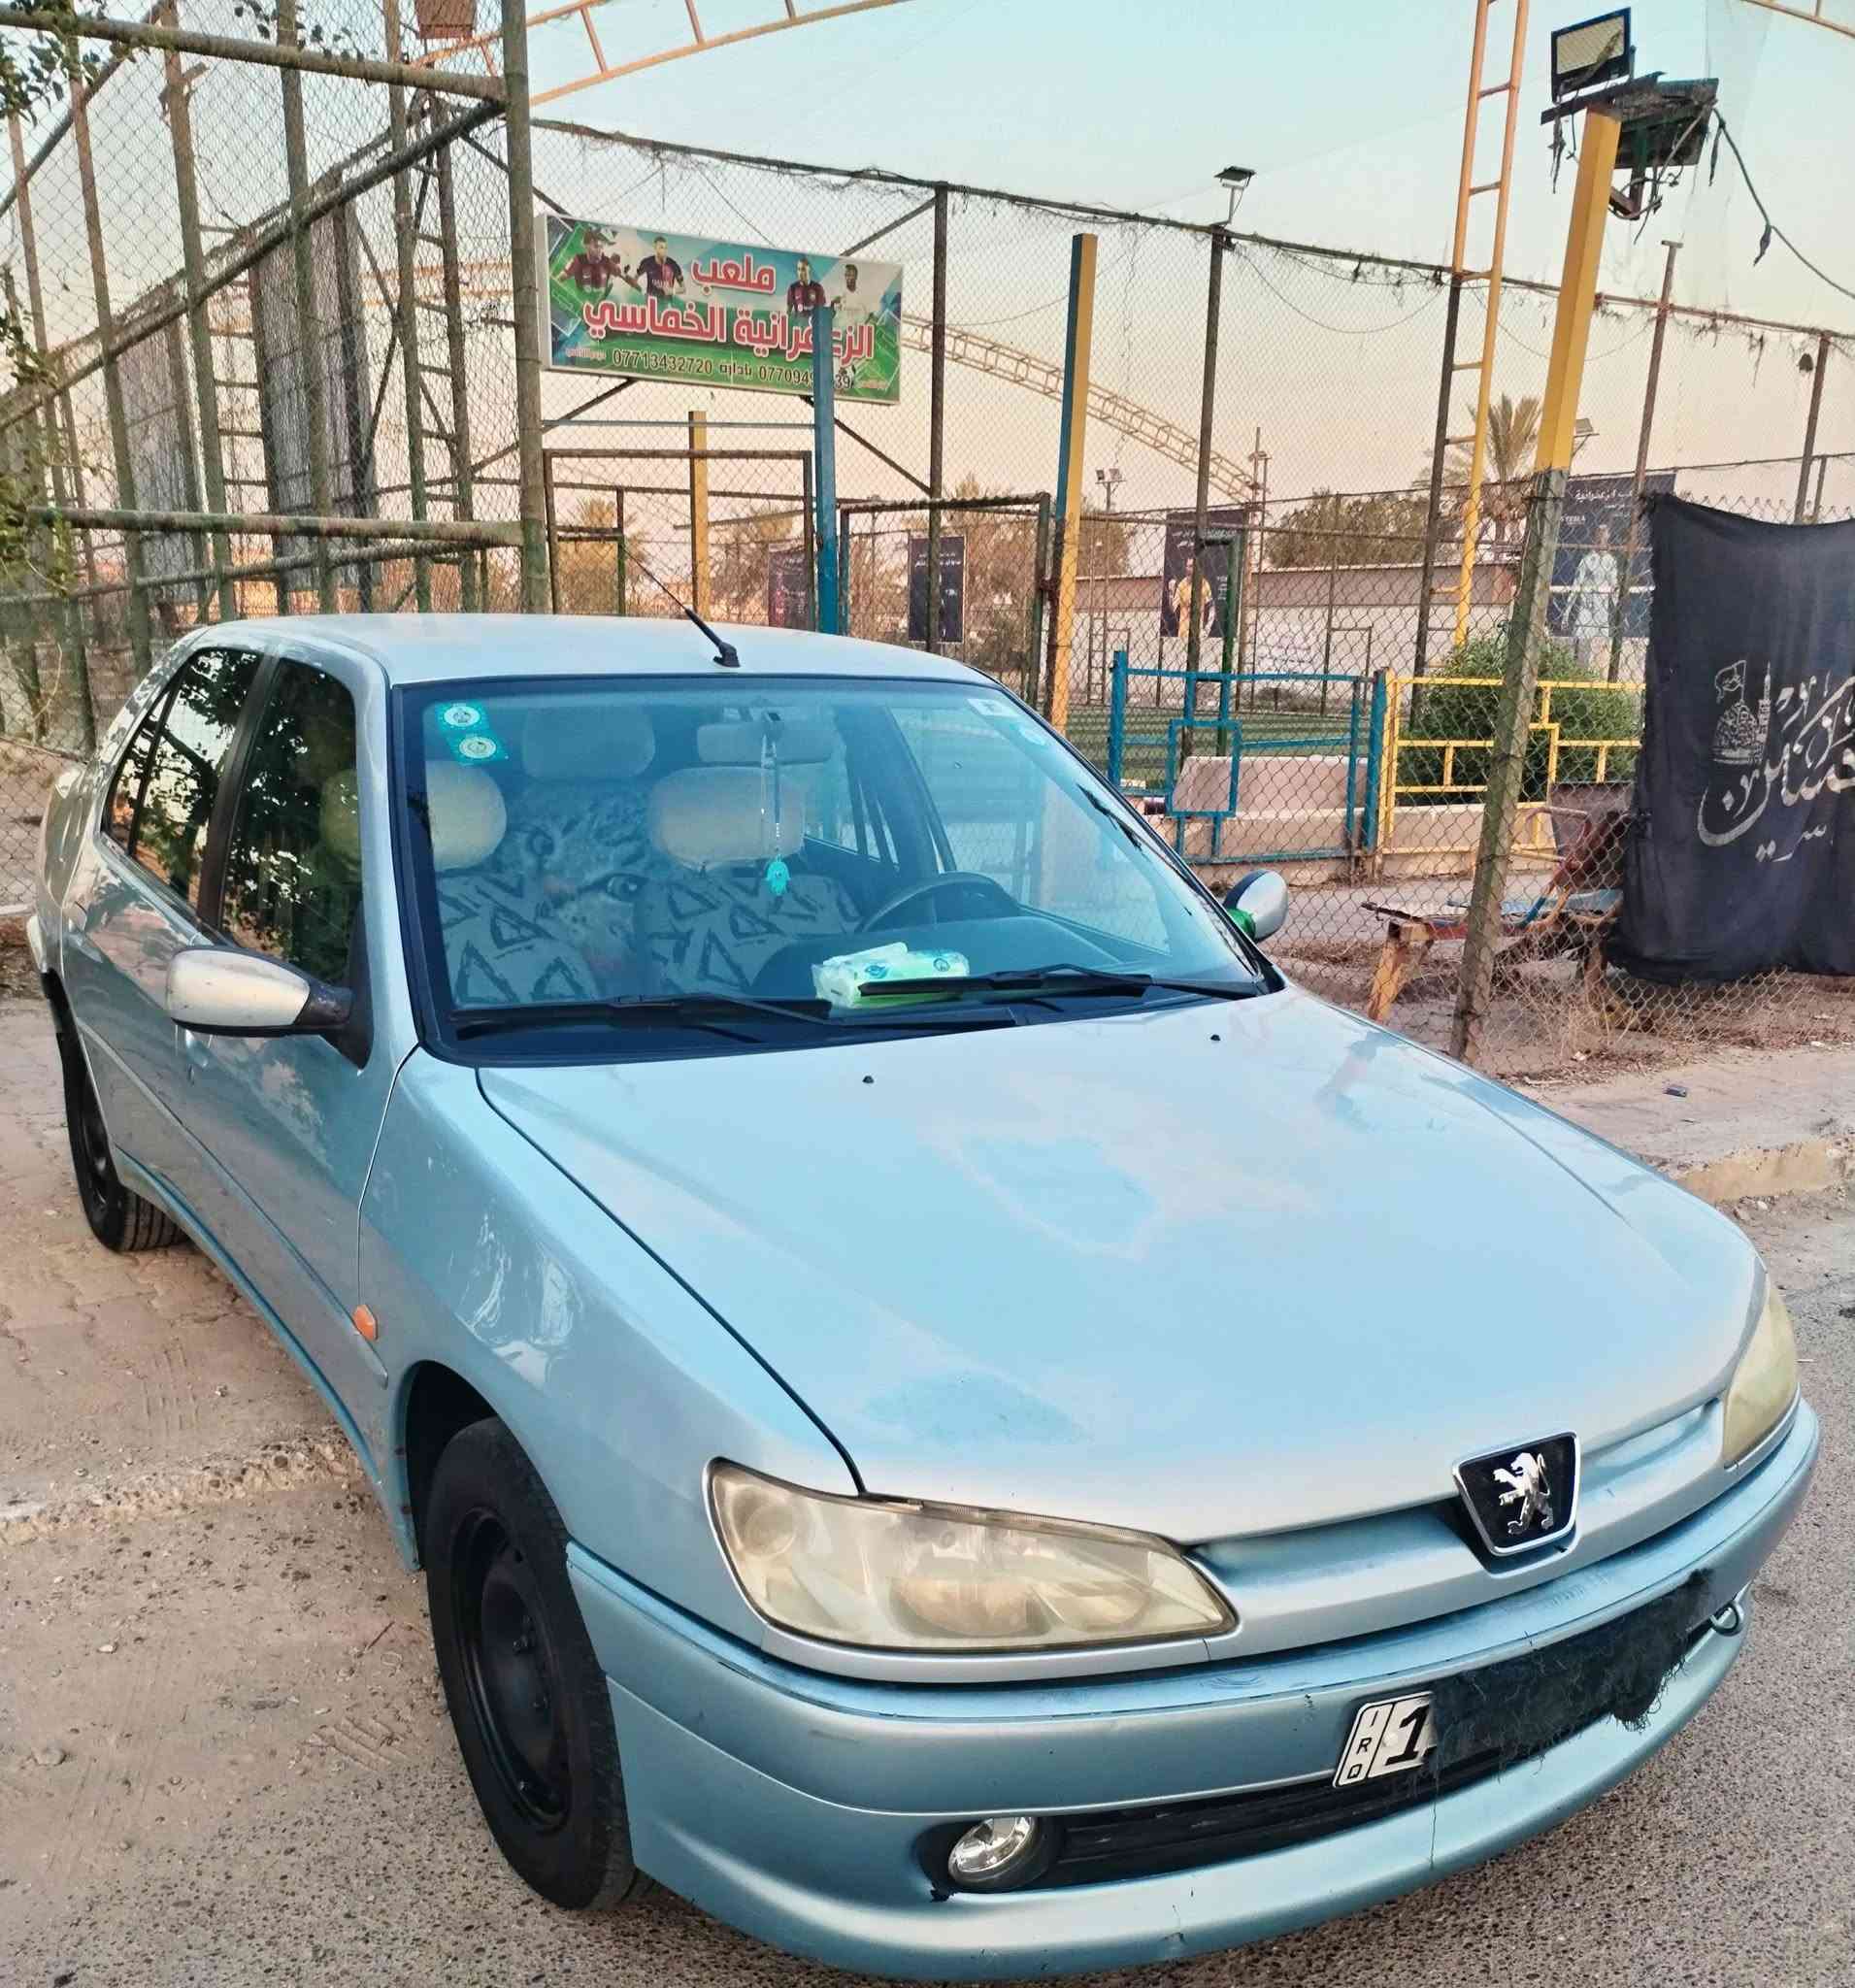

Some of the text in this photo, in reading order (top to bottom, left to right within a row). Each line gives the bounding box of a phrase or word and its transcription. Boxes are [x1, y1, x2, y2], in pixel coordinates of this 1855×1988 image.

[691, 253, 776, 293] ملعب
[582, 295, 726, 342] الخماسي
[613, 348, 713, 376] 07713432720
[759, 364, 850, 389] 07709439
